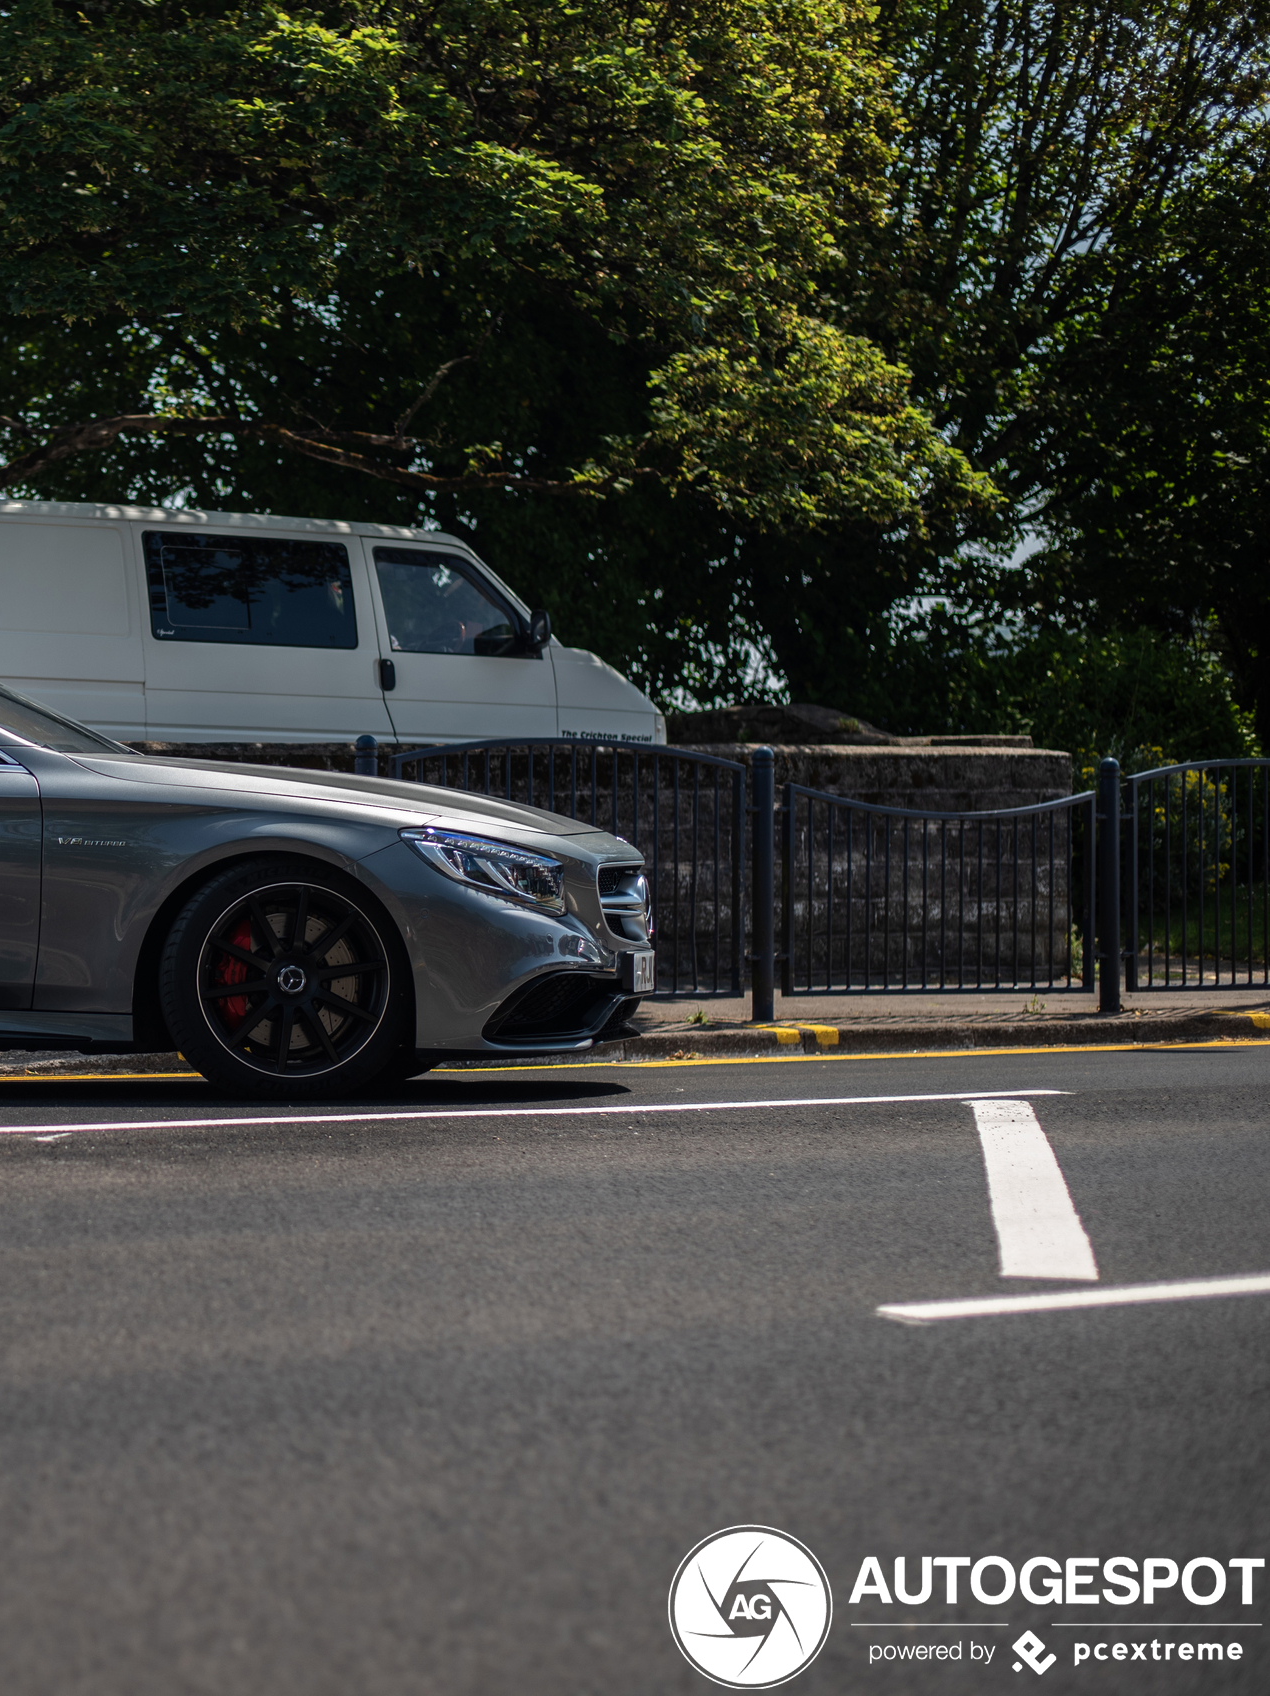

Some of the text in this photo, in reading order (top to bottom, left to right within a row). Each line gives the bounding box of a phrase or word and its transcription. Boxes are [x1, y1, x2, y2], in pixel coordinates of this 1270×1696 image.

[561, 730, 652, 743] The Crichton Special
[58, 837, 83, 845] V8
